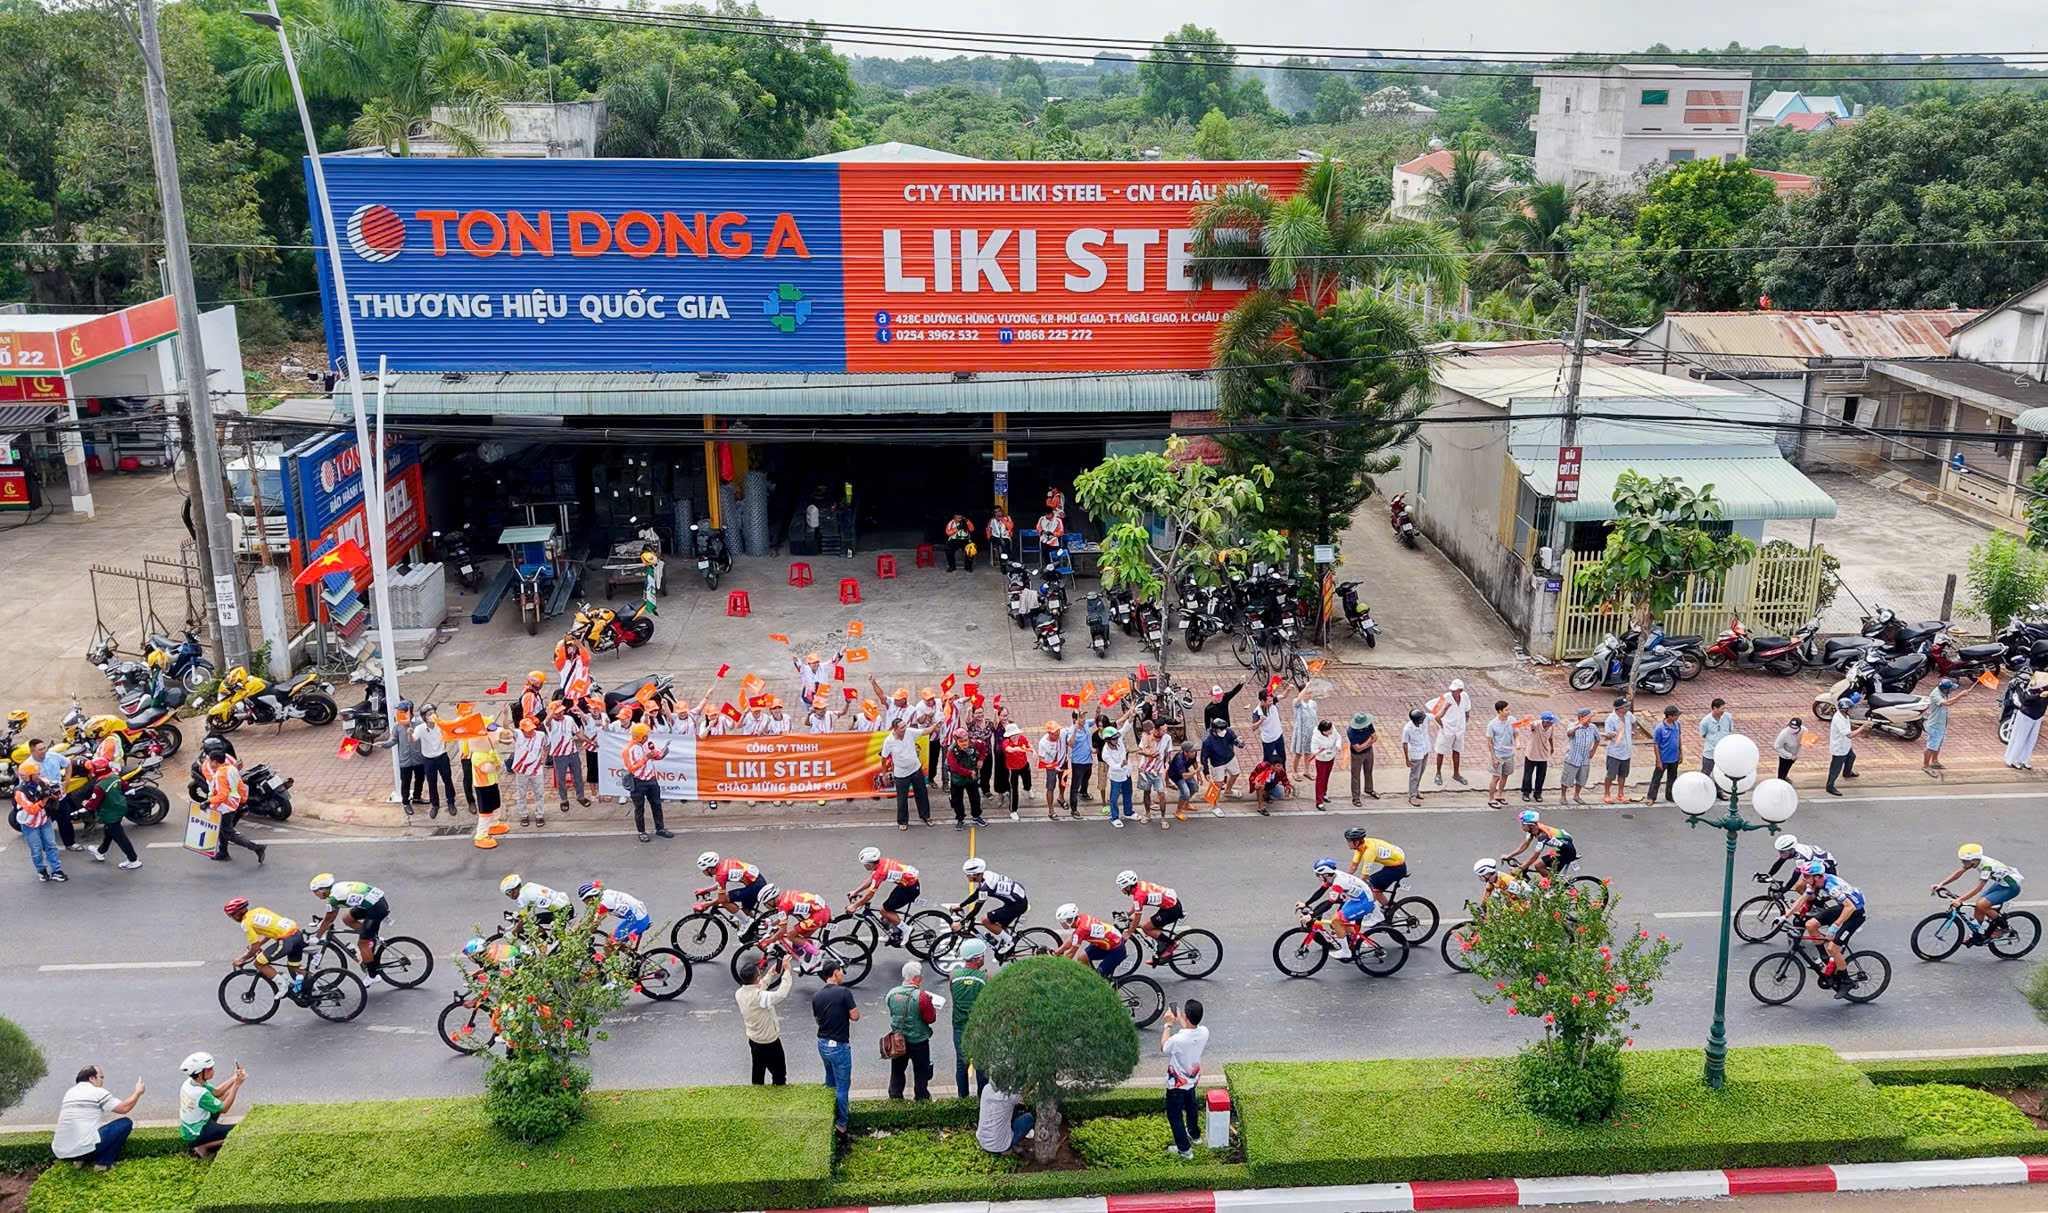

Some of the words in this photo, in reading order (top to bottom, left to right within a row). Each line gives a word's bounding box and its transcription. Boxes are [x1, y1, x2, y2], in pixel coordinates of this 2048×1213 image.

[904, 184, 943, 202] CTY
[949, 184, 1004, 202] TNHH
[1010, 184, 1047, 202] LIKI
[1052, 184, 1106, 202] STEEL
[1126, 184, 1155, 202] CN
[1161, 179, 1218, 202] CHÂU
[415, 210, 554, 258] TON
[568, 211, 753, 259] DONG
[763, 213, 812, 259] A
[883, 229, 1037, 292] LIKI
[353, 292, 492, 318] THƯƠNG
[503, 288, 568, 324] HIỆU
[579, 288, 666, 324] QUỐC
[677, 295, 730, 319] GIA
[895, 314, 921, 324] 428C
[923, 312, 963, 324] ĐƯỜNG
[965, 312, 995, 324] HÙNG
[997, 313, 1039, 325] VƯƠNG,
[1056, 311, 1077, 324] PHÚ
[1080, 314, 1106, 325] GIAO,
[1109, 314, 1122, 324] TT.
[1152, 314, 1178, 325] GIAO,
[1181, 314, 1190, 323] H.
[1192, 311, 1219, 324] CHÂU
[896, 330, 925, 341] 0254
[928, 330, 956, 341] 3962
[958, 330, 979, 341] 532
[1017, 330, 1045, 341] 0868
[1048, 330, 1068, 341] 225
[1071, 330, 1092, 341] 272
[17, 350, 46, 366] 22
[745, 742, 774, 753] CÔNG
[776, 743, 788, 753] TY
[790, 743, 819, 752] TNHH
[725, 760, 766, 778] LIKI
[773, 760, 837, 777] STEEL
[716, 780, 749, 792] CHÀO
[752, 780, 787, 793] MỪNG
[789, 779, 821, 792] ĐOÀN
[190, 816, 218, 831] SPRINT
[199, 830, 206, 848] 1
[999, 883, 1010, 893] 91
[349, 894, 362, 904] 52
